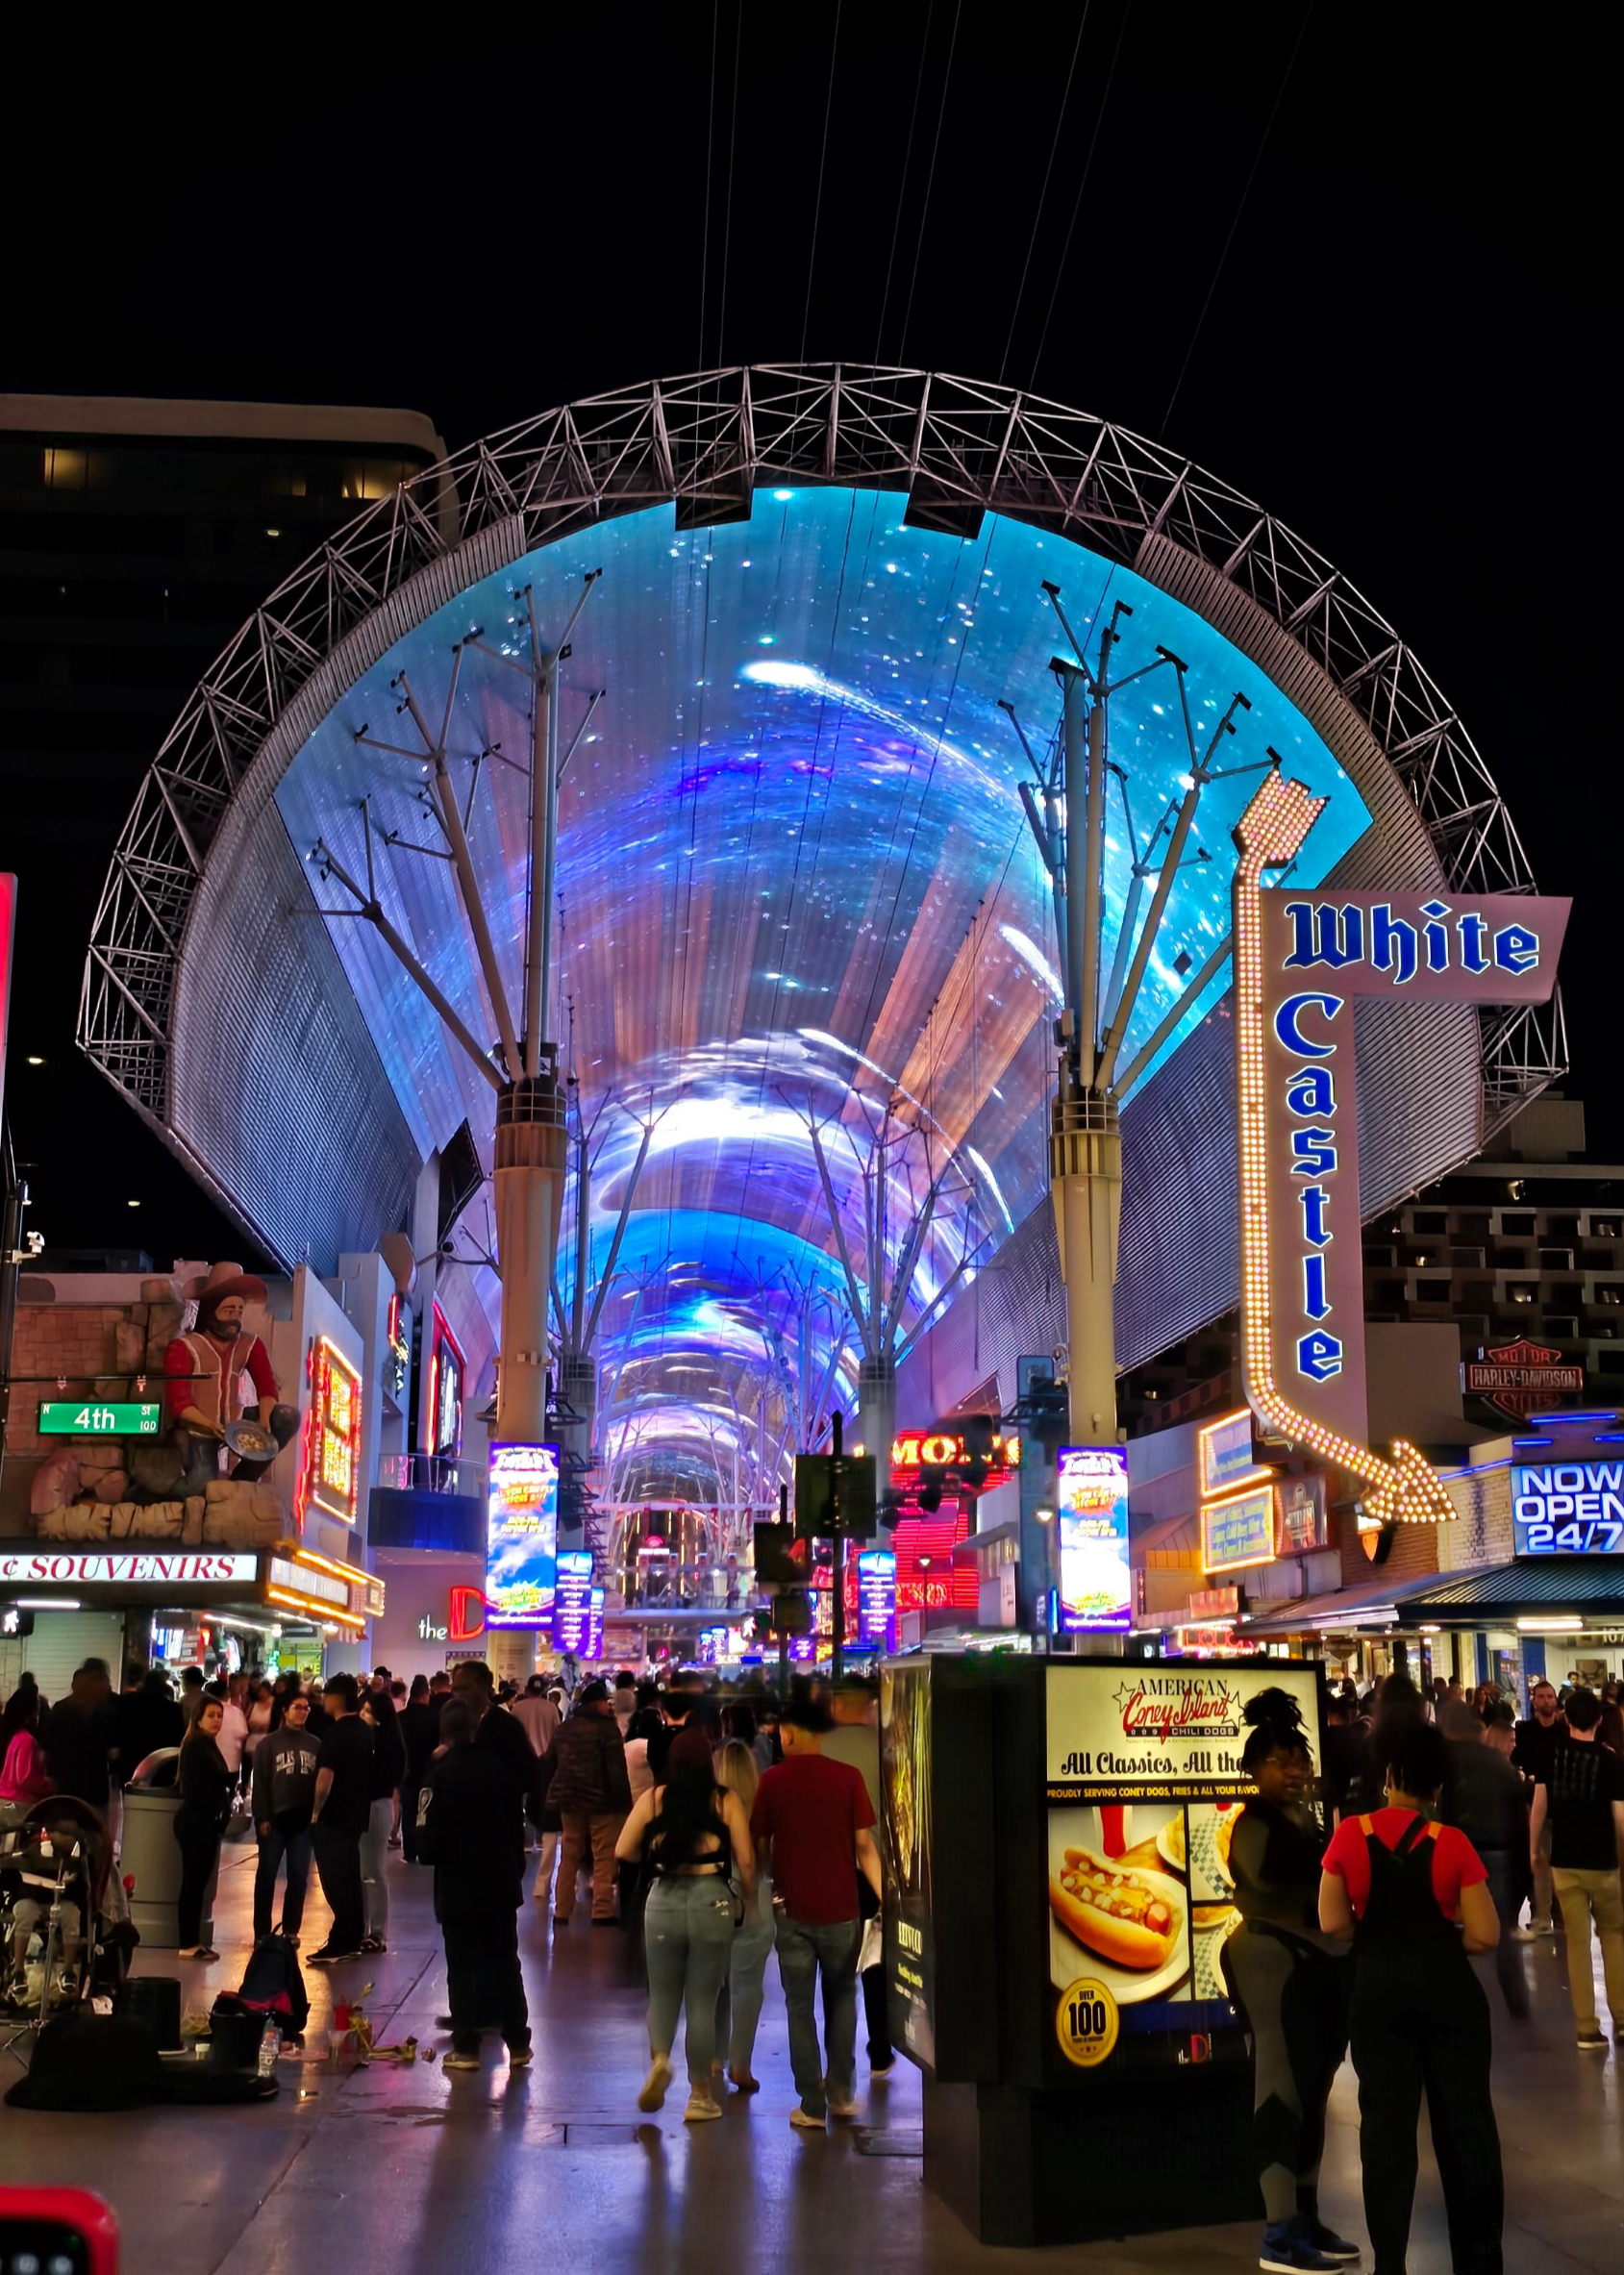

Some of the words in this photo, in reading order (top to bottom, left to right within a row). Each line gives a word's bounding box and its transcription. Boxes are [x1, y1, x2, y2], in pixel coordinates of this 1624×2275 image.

[1282, 899, 1539, 985] White
[1274, 991, 1345, 1383] Castle
[1498, 1345, 1550, 1362] MOTOR
[1474, 1367, 1577, 1388] HARLEY-DAVIDSON
[42, 1405, 51, 1414] N
[74, 1408, 115, 1430] 4th
[141, 1406, 151, 1415] St
[139, 1420, 157, 1431] 100
[1521, 1463, 1624, 1495] NOW
[1514, 1492, 1624, 1523] OPEN
[1527, 1522, 1624, 1552] 24/7
[27, 1556, 236, 1580] SOUVENIRS
[418, 1614, 448, 1640] the
[450, 1585, 487, 1641] D
[1137, 1679, 1228, 1696] AMERICAN
[1123, 1691, 1174, 1745] Coney
[1173, 1687, 1231, 1726] Island
[1171, 1727, 1201, 1736] CHILI
[1204, 1727, 1235, 1736] DOGS
[1061, 1752, 1093, 1775] All
[1096, 1751, 1178, 1777] Classics,
[1183, 1751, 1213, 1773] All
[1047, 1788, 1082, 1798] PROUDLY
[1084, 1788, 1117, 1798] SERVING
[1118, 1787, 1145, 1797] CONEY
[1146, 1787, 1171, 1797] DOGS,
[1172, 1787, 1191, 1796] FRIES
[1192, 1787, 1199, 1795] &
[1201, 1786, 1213, 1795] ALL
[1214, 1786, 1237, 1795] YOUR
[1079, 1990, 1094, 2000] OVER
[1068, 2000, 1107, 2037] 100
